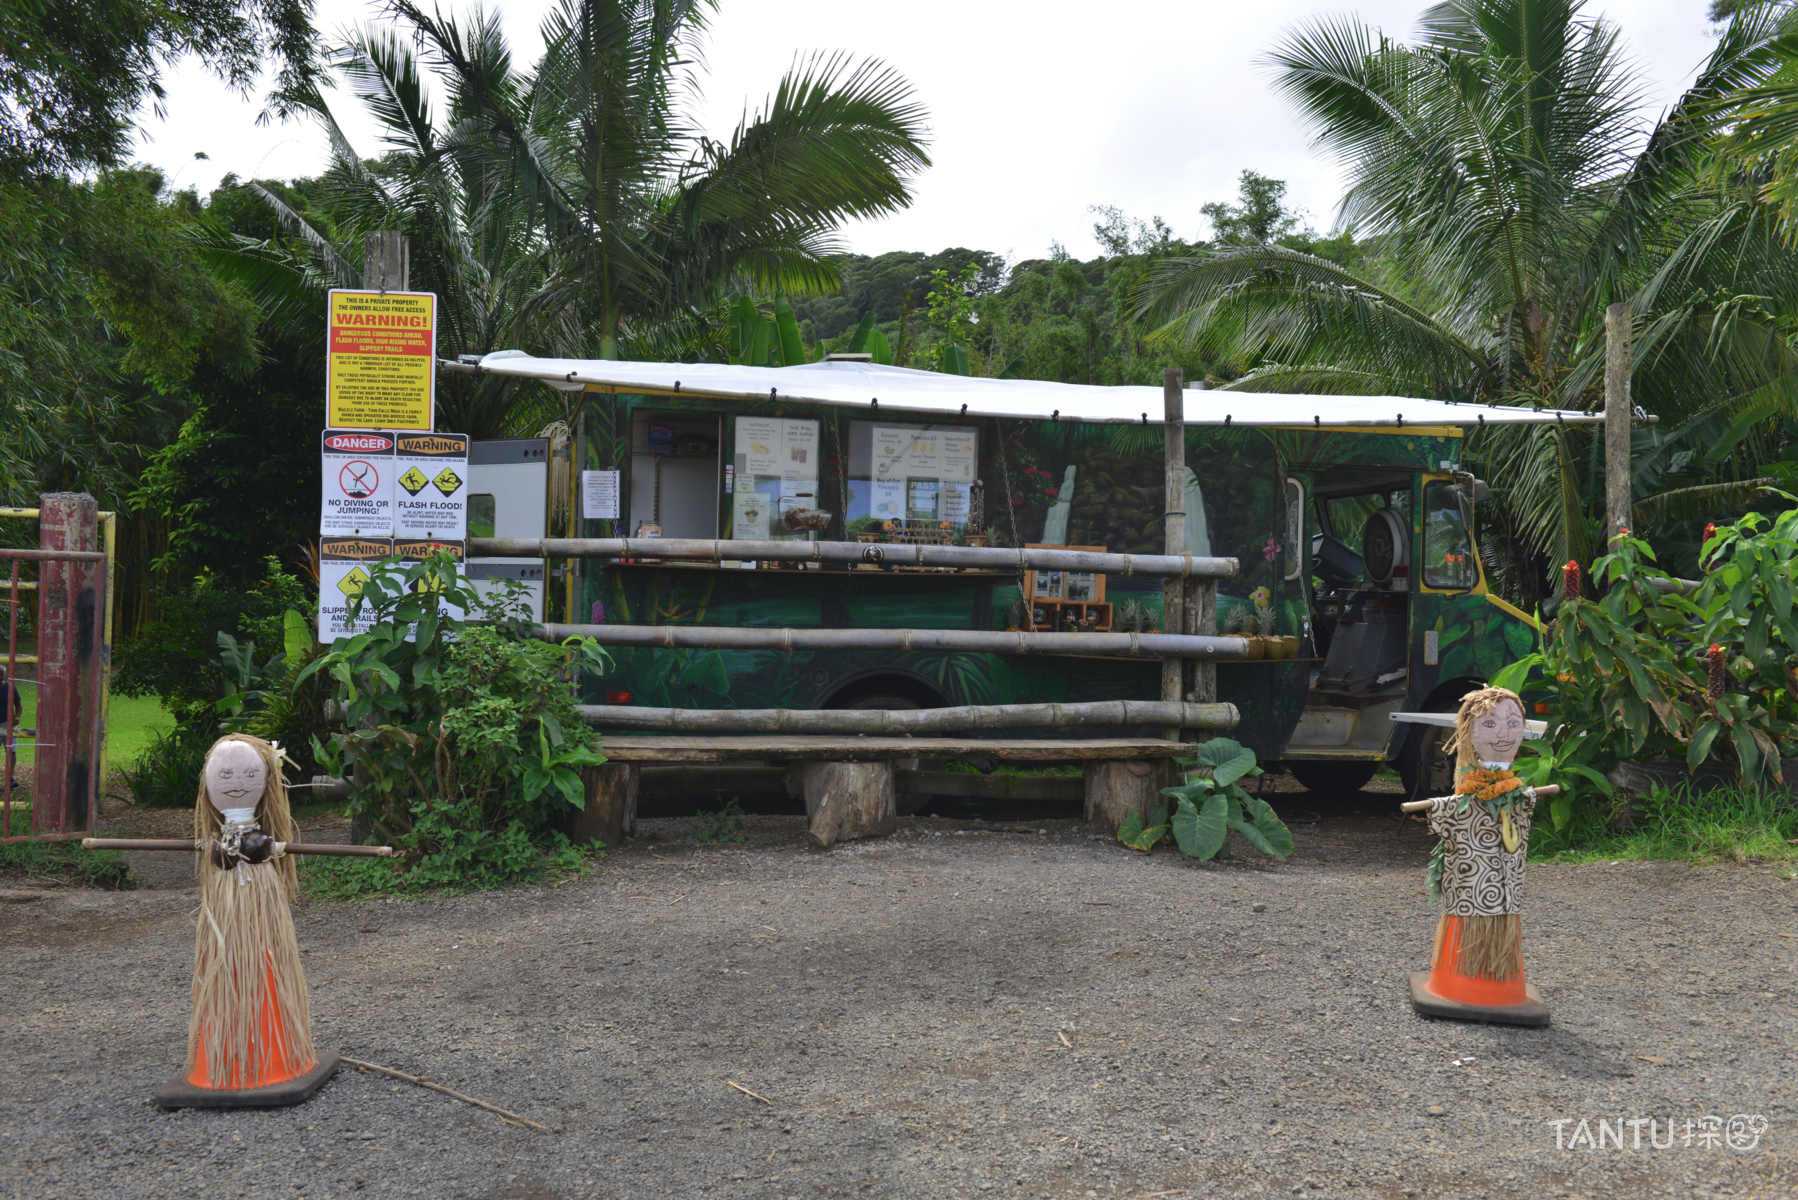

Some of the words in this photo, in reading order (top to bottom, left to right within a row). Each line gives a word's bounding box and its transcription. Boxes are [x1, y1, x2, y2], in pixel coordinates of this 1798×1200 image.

[336, 314, 427, 327] WARNING!
[333, 438, 385, 449] DANGER
[403, 440, 461, 451] WARNING
[328, 545, 386, 555] WARNING
